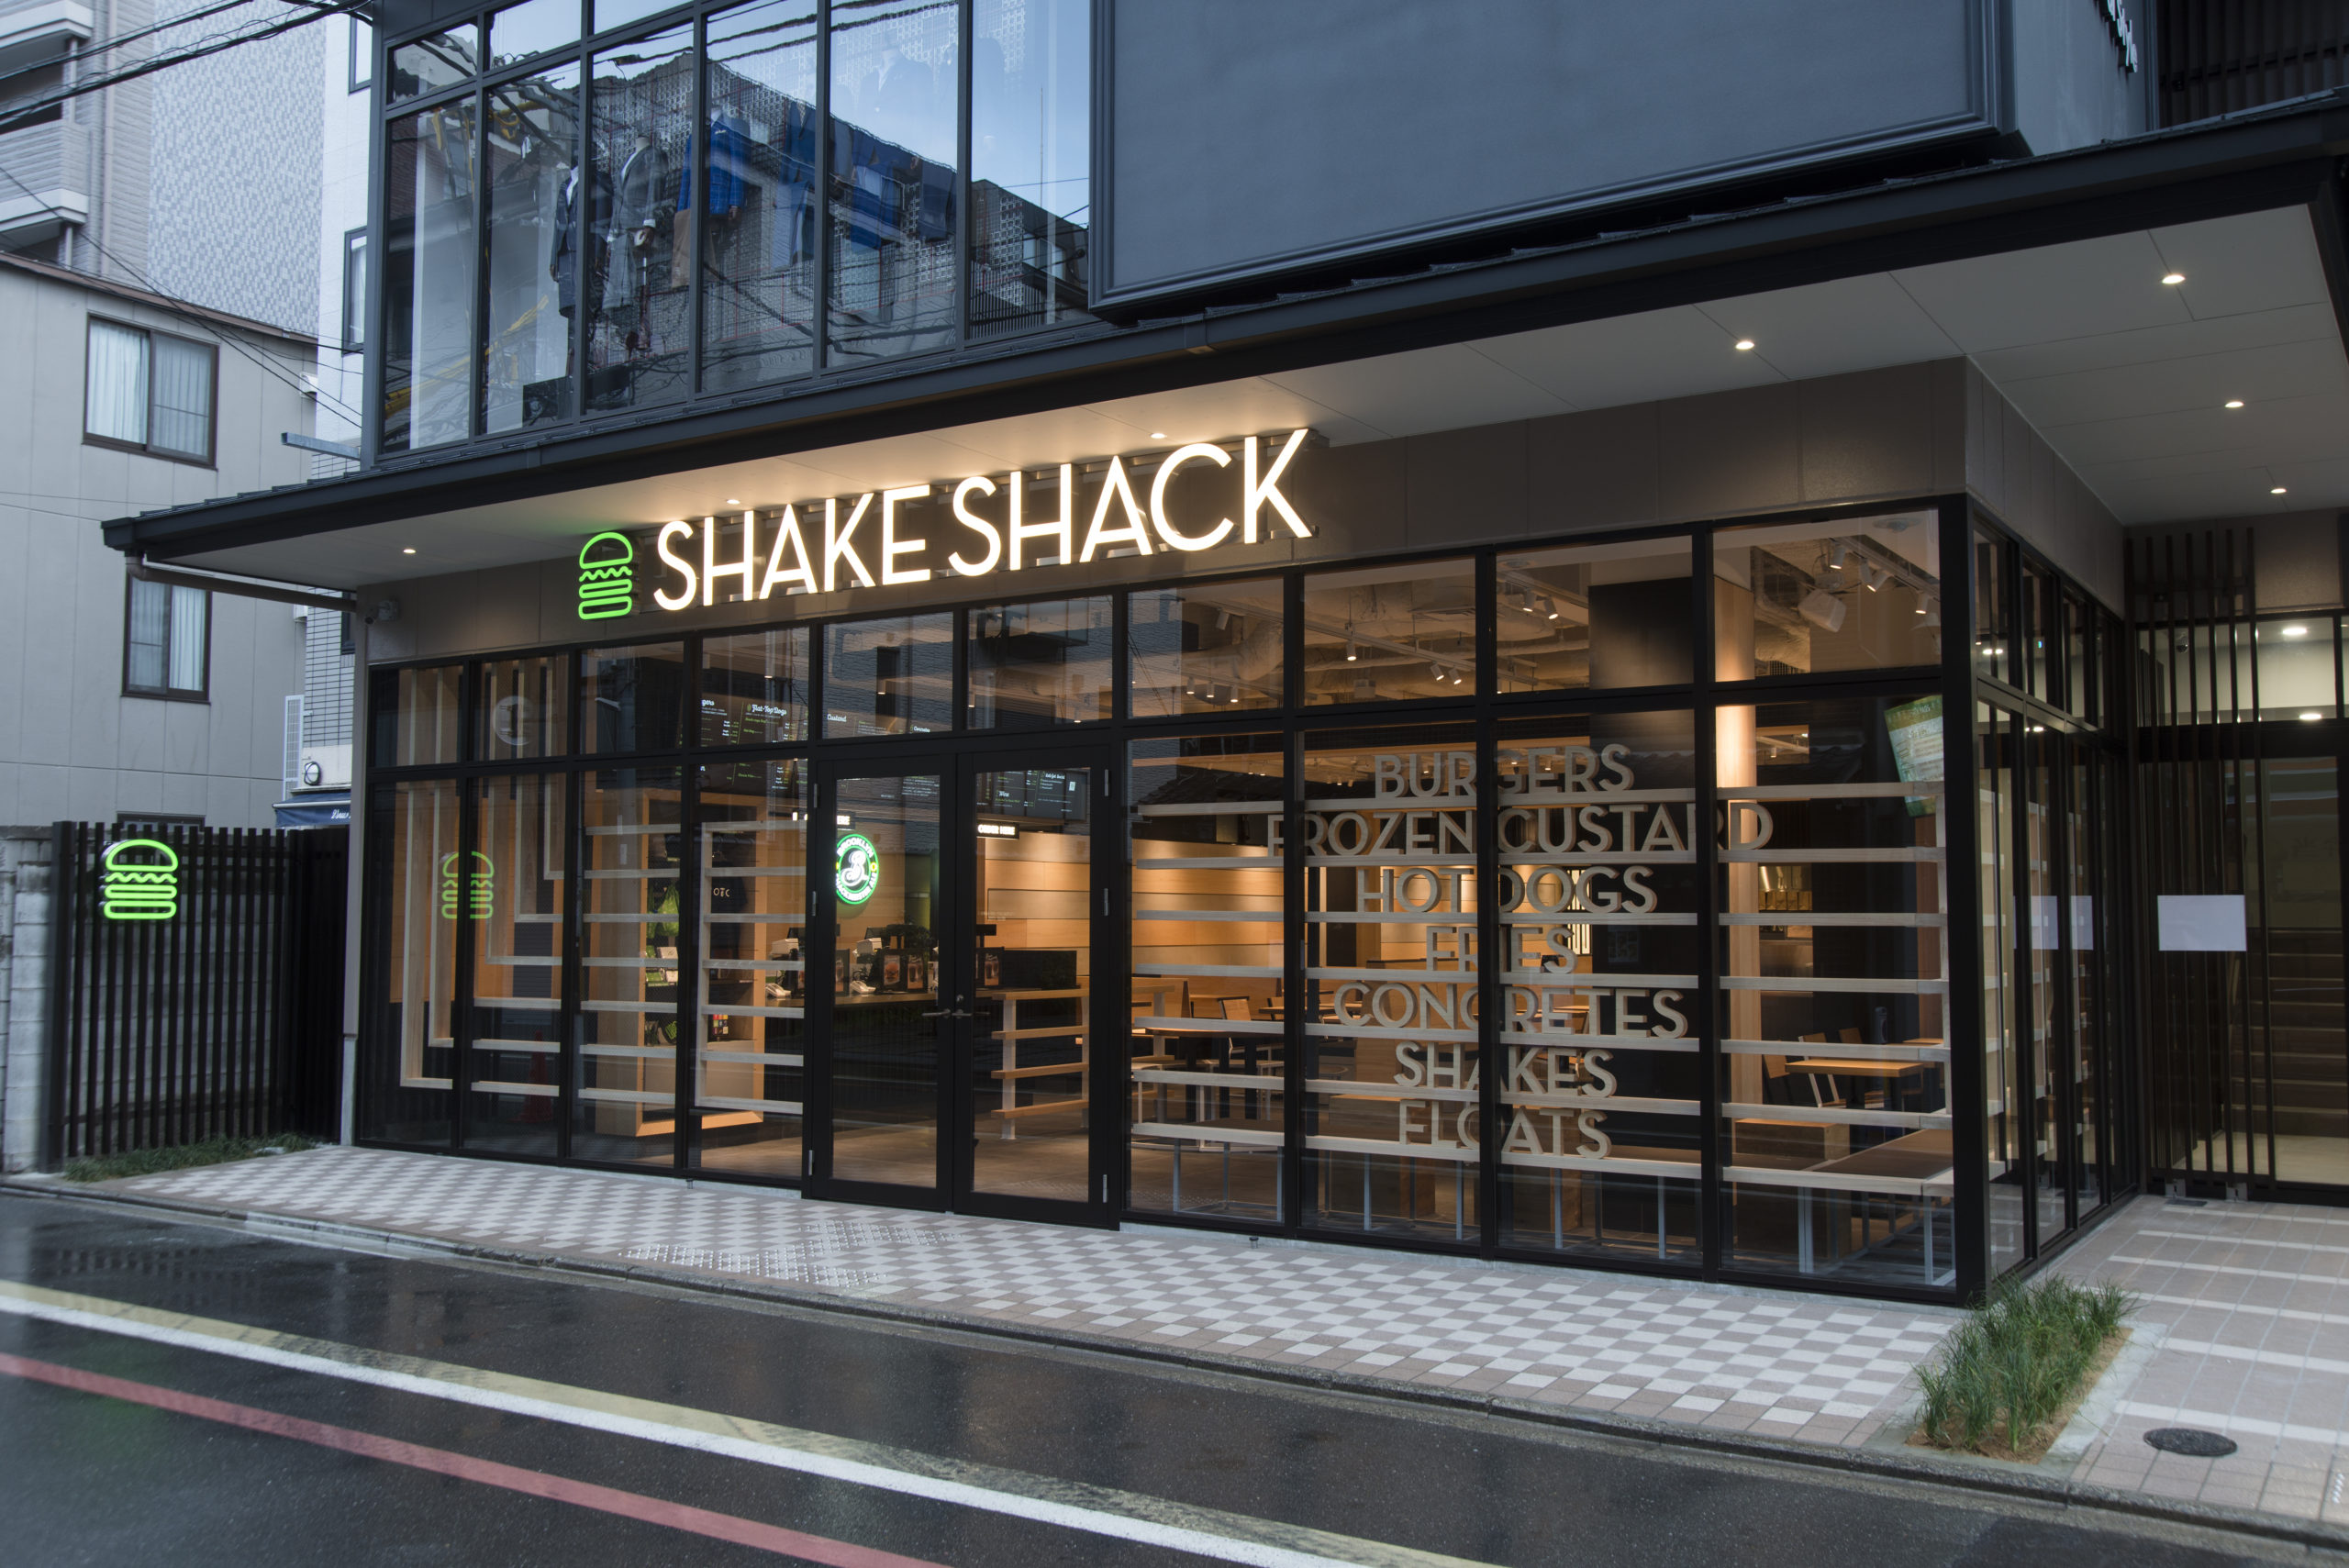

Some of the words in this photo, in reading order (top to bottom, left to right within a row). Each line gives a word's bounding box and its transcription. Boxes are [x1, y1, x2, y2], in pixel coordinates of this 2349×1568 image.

[653, 484, 930, 612] SHAKE
[948, 428, 1313, 577] SHACK
[1375, 743, 1635, 798] BURGERS
[836, 837, 874, 858] BROOKLYN
[1267, 808, 1477, 857] FROZEN
[1497, 801, 1774, 853] CUSTARD
[1357, 866, 1475, 914] HOT
[1498, 864, 1658, 914] DOGS
[1426, 925, 1578, 975] FRIES
[1334, 982, 1688, 1040] CONCRETES
[1398, 1100, 1612, 1160] FLOATS
